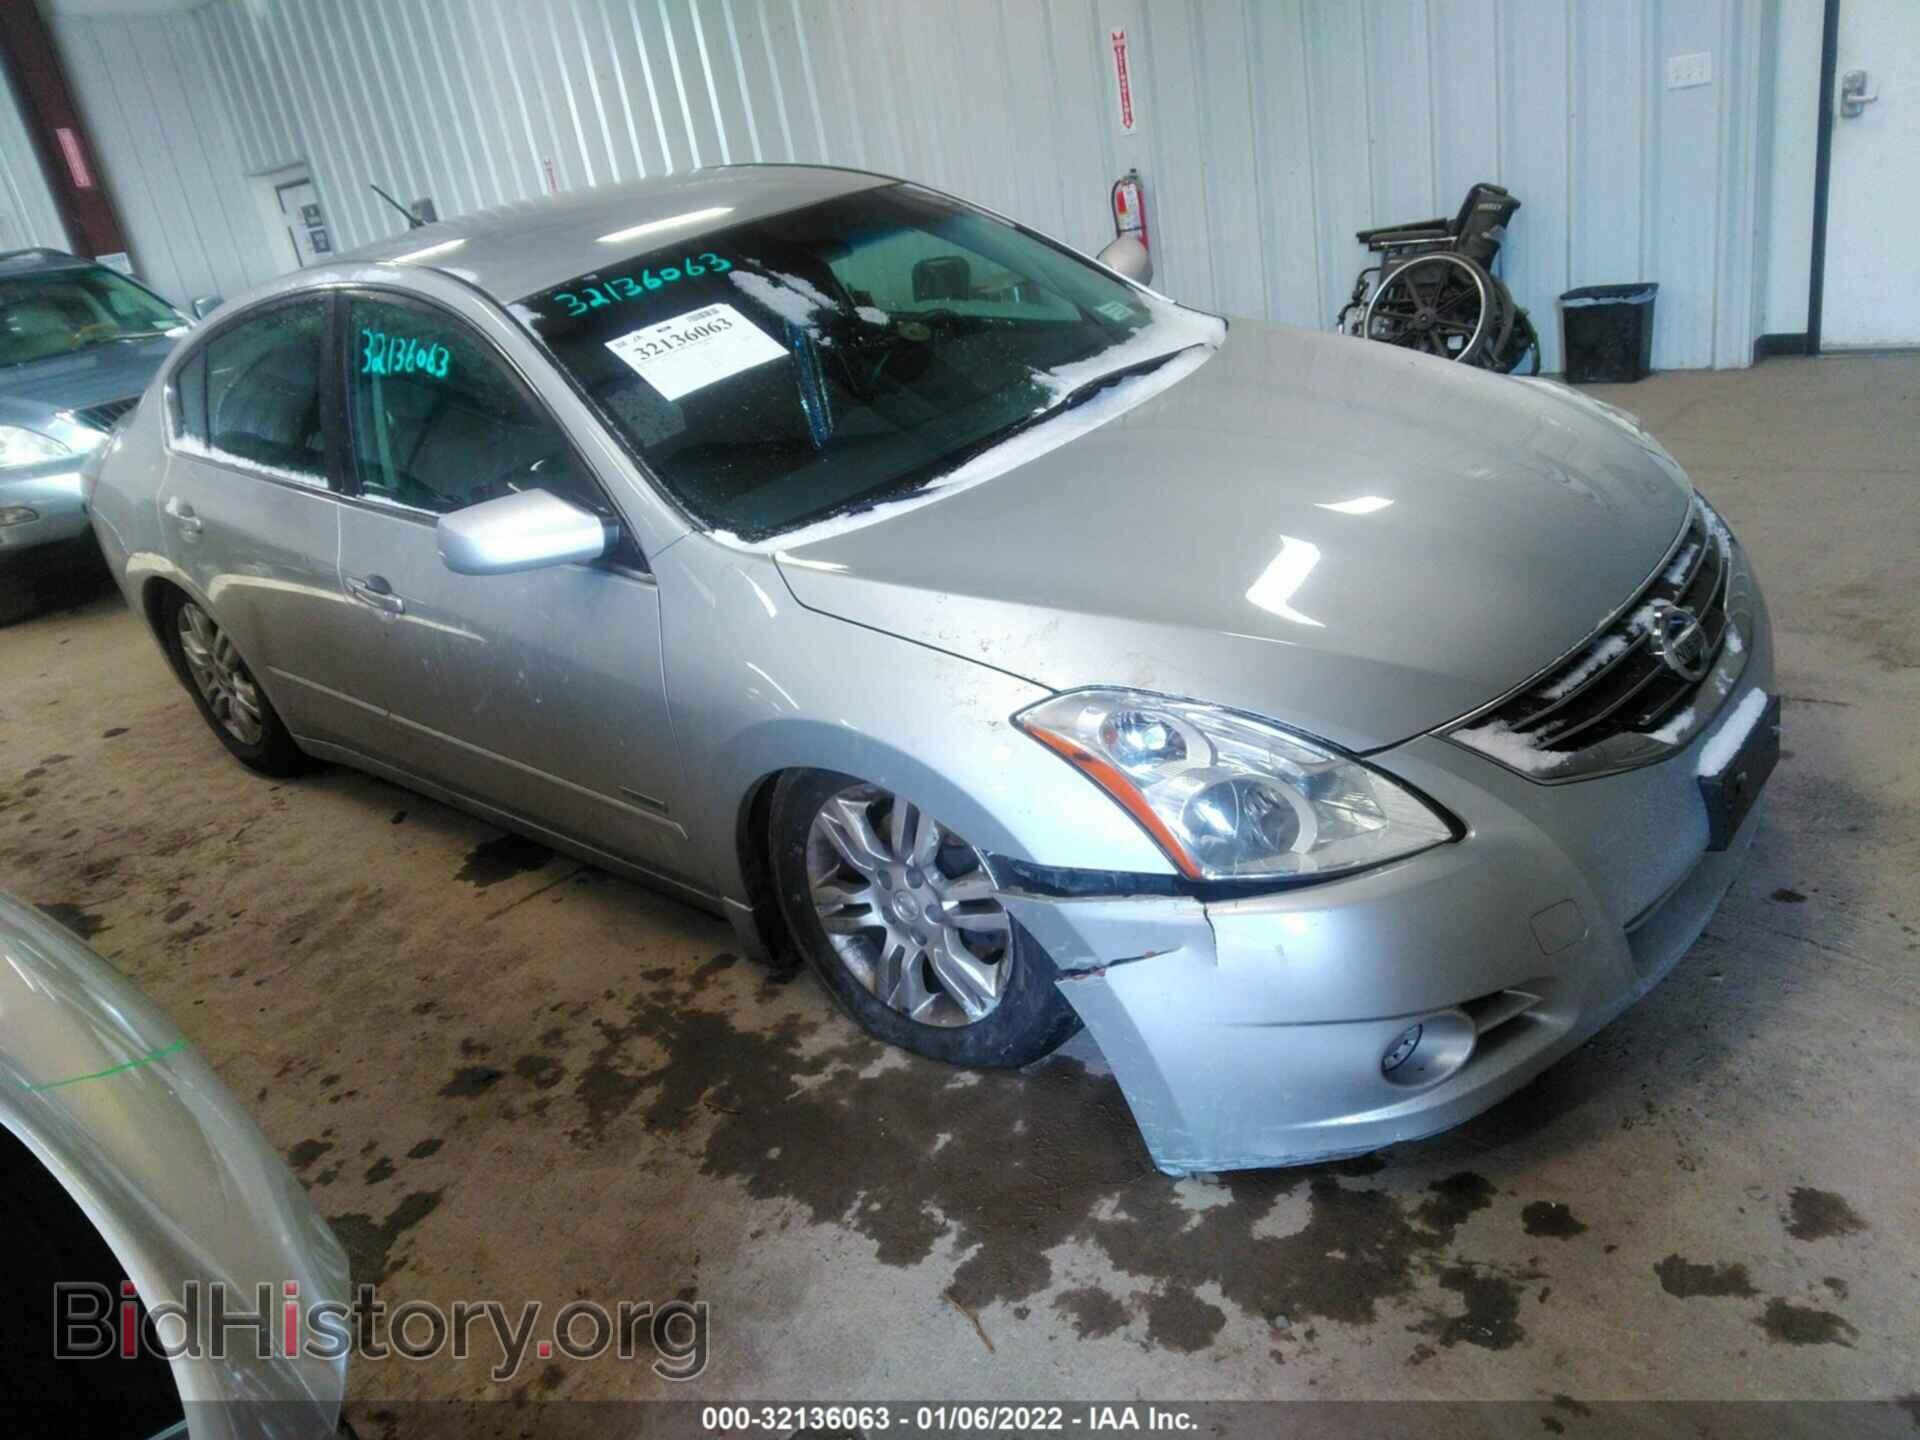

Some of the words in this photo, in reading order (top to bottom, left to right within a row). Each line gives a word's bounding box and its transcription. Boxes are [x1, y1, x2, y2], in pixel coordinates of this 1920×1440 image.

[554, 252, 733, 316] 32136063
[361, 328, 450, 378] 32136063
[634, 317, 733, 360] 32136063
